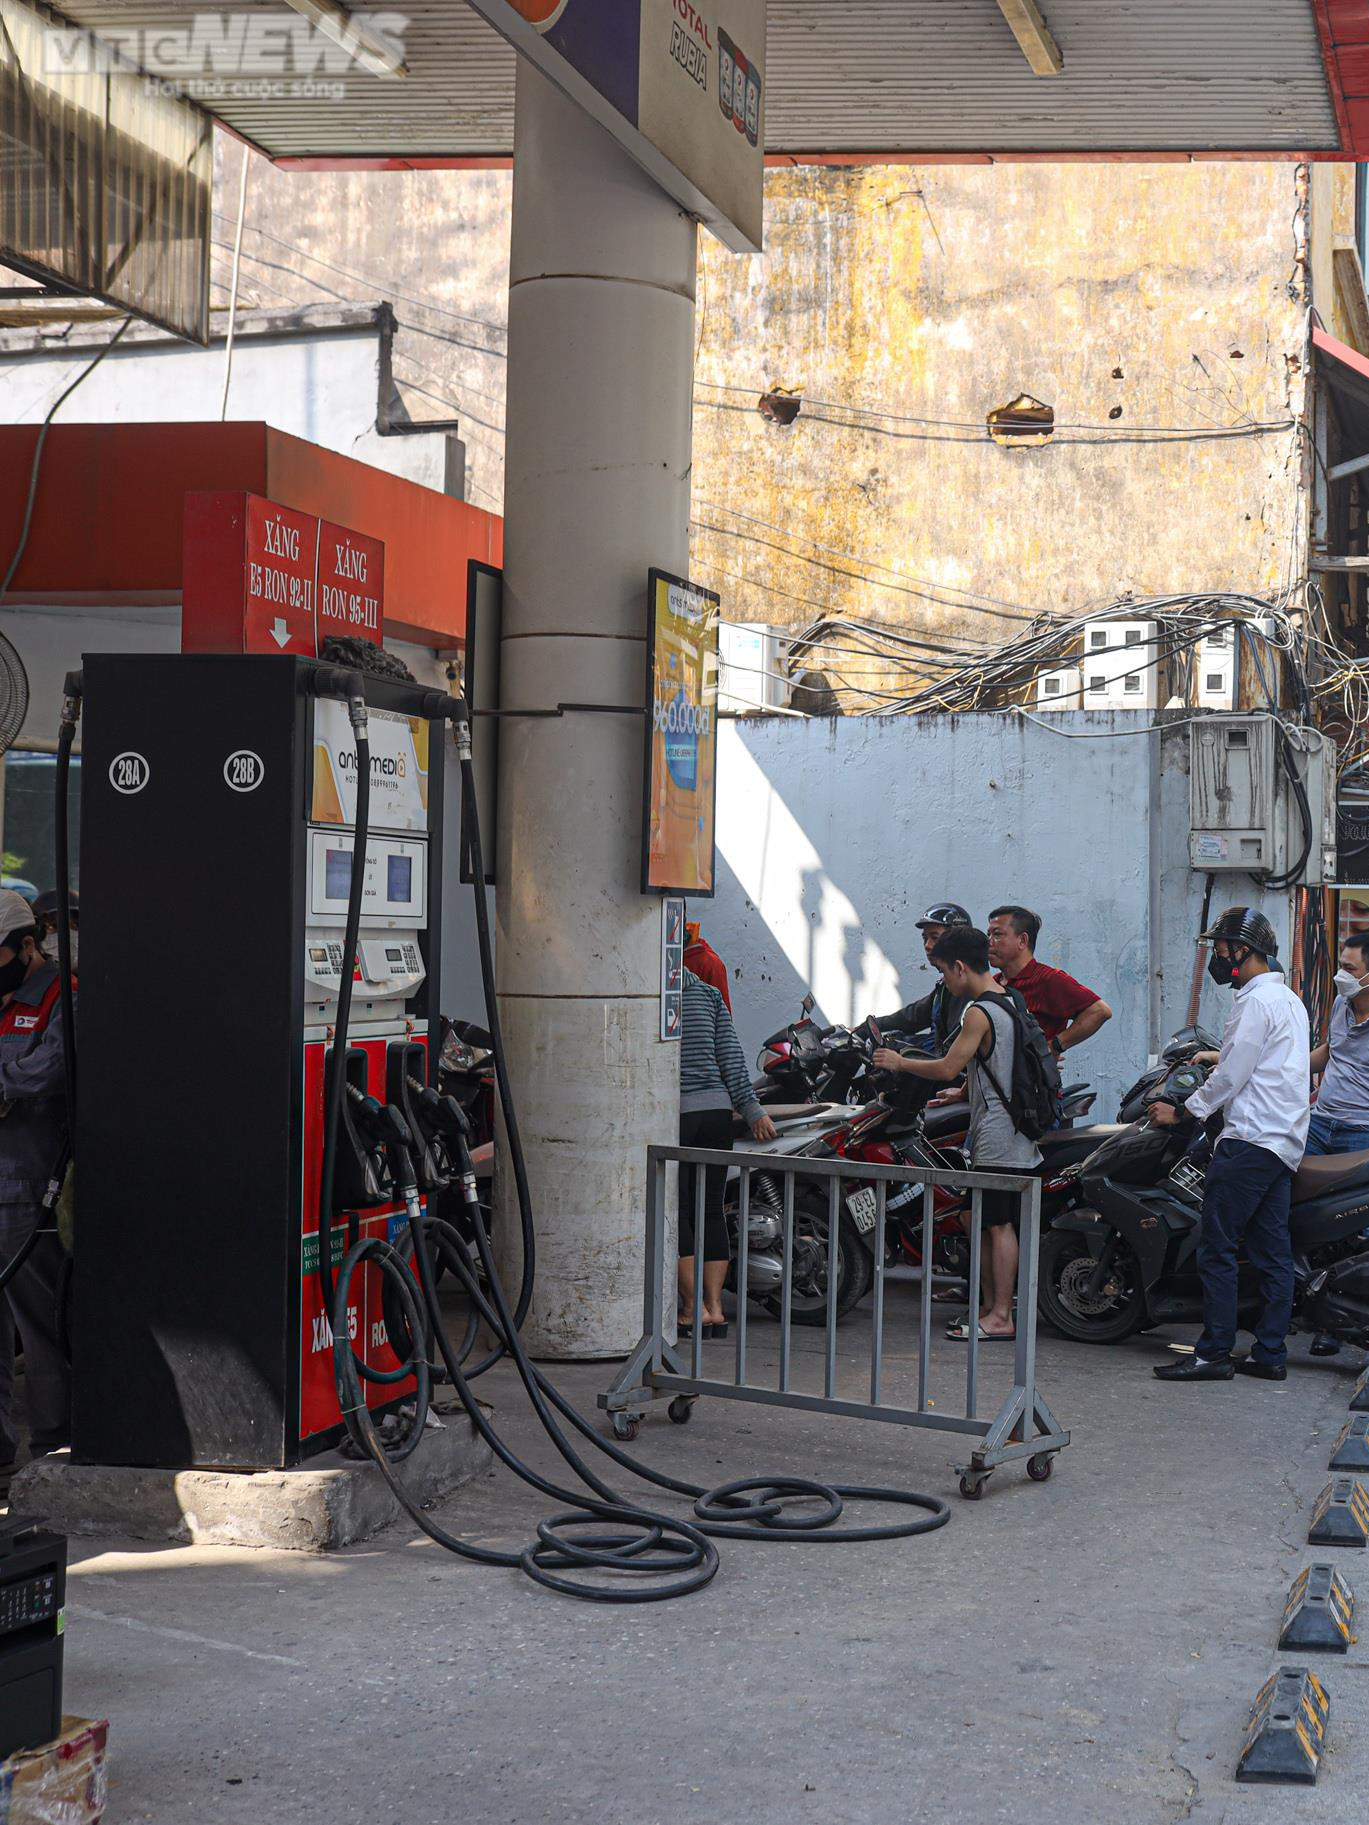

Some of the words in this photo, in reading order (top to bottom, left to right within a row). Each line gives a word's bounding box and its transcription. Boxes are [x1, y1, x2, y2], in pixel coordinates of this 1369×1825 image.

[670, 20, 706, 91] RUBIA
[264, 513, 299, 561] XĂNG
[335, 538, 367, 584] XĂNG
[250, 562, 262, 596] E5
[264, 567, 288, 604] RON
[290, 578, 312, 611] 92-II
[322, 584, 347, 621] RON
[349, 595, 378, 629] 95-III
[118, 759, 140, 786] 28A
[232, 759, 255, 785] 28B
[312, 1308, 334, 1354] XĂN
[372, 1319, 389, 1348] RO
